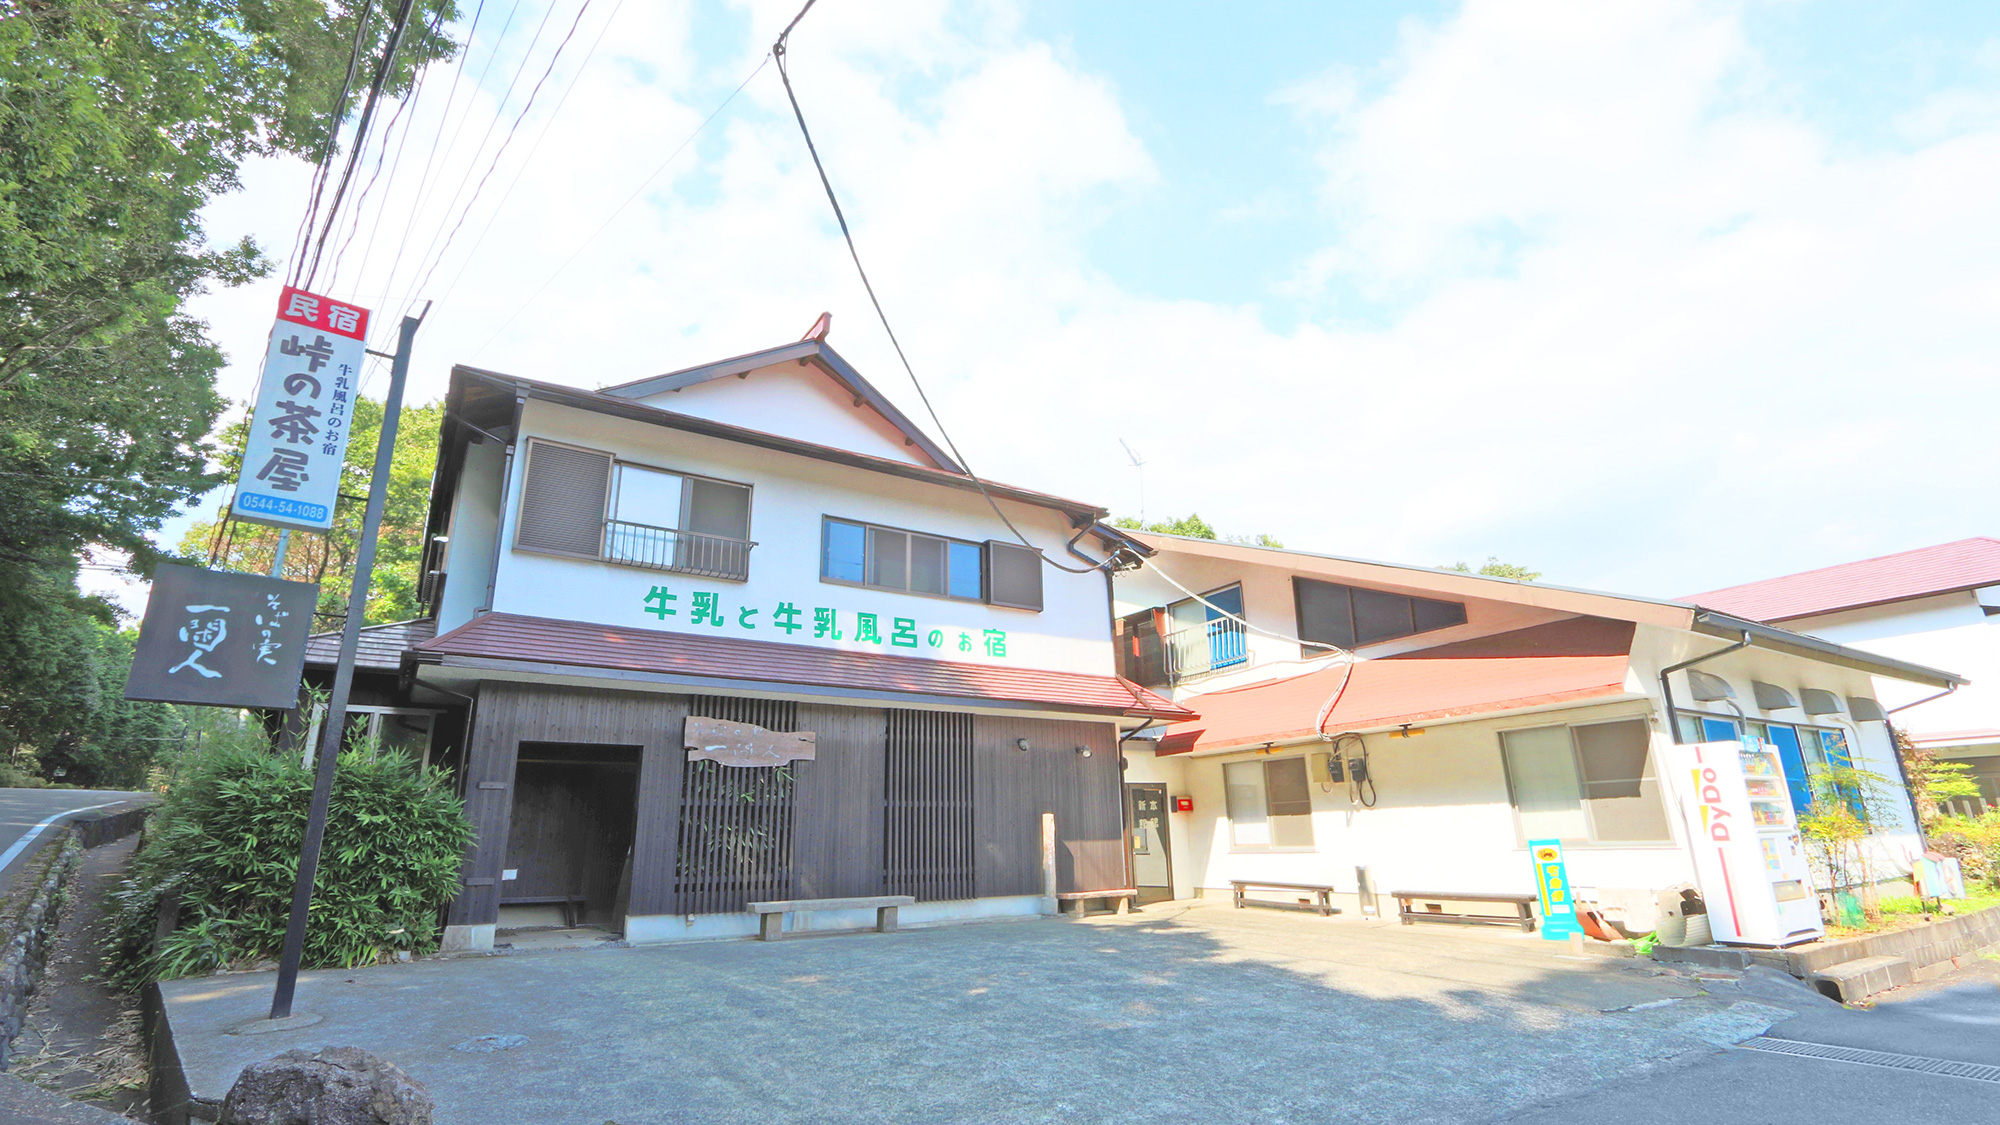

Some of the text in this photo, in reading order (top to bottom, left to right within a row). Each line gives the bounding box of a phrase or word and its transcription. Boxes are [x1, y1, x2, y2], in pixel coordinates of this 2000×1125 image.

[285, 293, 360, 333] 民宿
[256, 335, 334, 491] 峠の茶屋
[322, 364, 352, 456] 牛乳風呂のお宿
[243, 495, 324, 519] 0544-54-1088
[643, 585, 1007, 658] 牛乳と牛乳風呂のお宿
